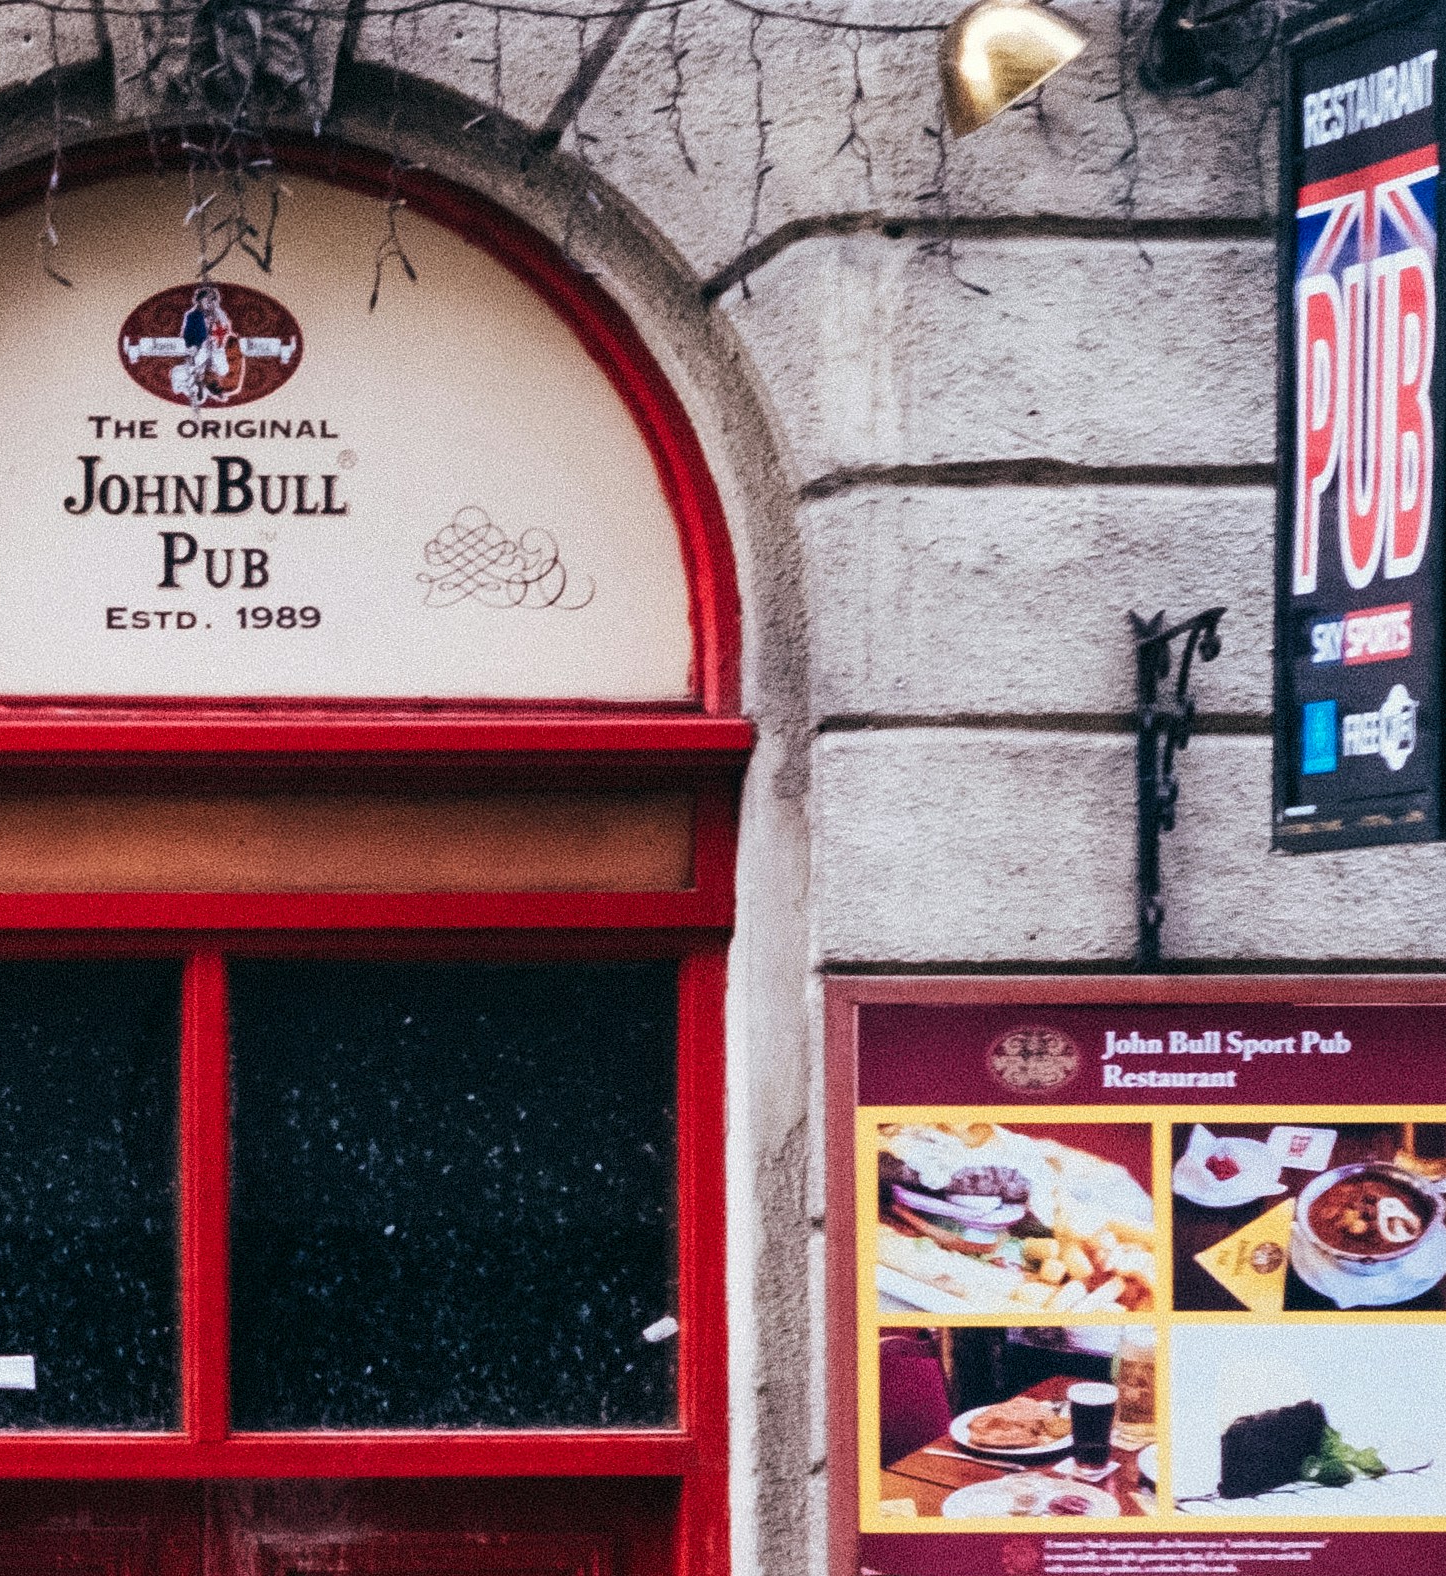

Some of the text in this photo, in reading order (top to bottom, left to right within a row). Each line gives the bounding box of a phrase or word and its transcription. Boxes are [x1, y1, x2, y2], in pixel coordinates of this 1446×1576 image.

[1303, 49, 1438, 150] RESTAURANT
[88, 416, 338, 440] THE ORIGINAL
[1293, 248, 1435, 596] PUB
[157, 531, 269, 589] PUB
[236, 605, 322, 630] 1989
[1311, 609, 1411, 664] SKY SPORTS
[1100, 1030, 1352, 1062] John Bull Sport Pub
[1103, 1064, 1237, 1088] Restaurant
